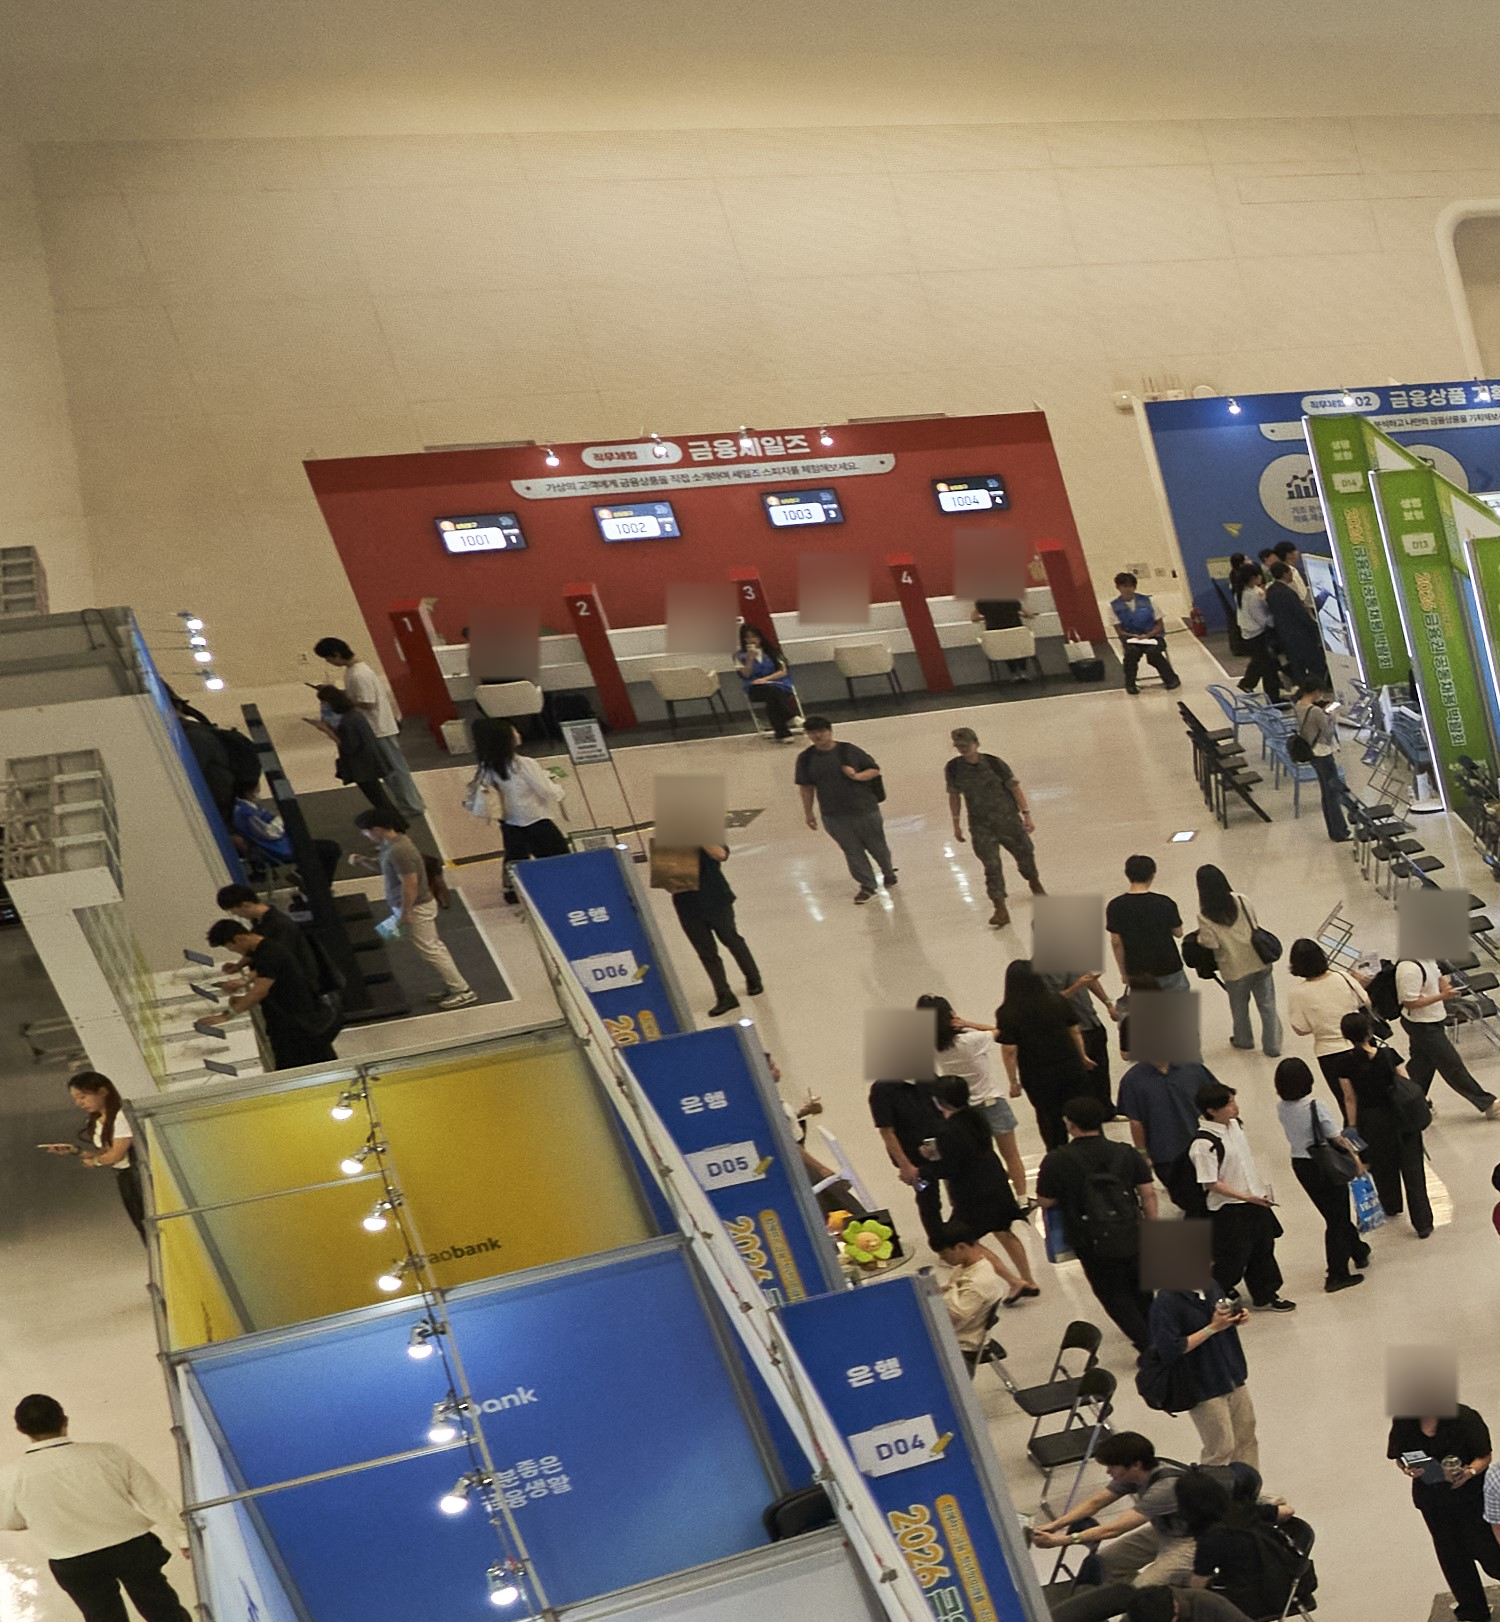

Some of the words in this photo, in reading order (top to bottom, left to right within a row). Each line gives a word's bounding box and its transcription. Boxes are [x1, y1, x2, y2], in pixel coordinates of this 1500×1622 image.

[1389, 388, 1466, 408] 금융상품
[688, 435, 810, 461] 금융세일즈
[951, 495, 980, 507] 1004
[782, 509, 813, 521] 1003
[615, 522, 648, 536] 1002
[459, 534, 490, 547] 1001
[901, 571, 912, 584] 4
[743, 586, 755, 600] 3
[577, 602, 590, 617] 2
[566, 906, 608, 928] 은행
[591, 964, 627, 982] D06
[680, 1092, 727, 1115] 은행
[705, 1156, 748, 1176] D05
[844, 1359, 902, 1388] 은행
[875, 1435, 923, 1461] D04
